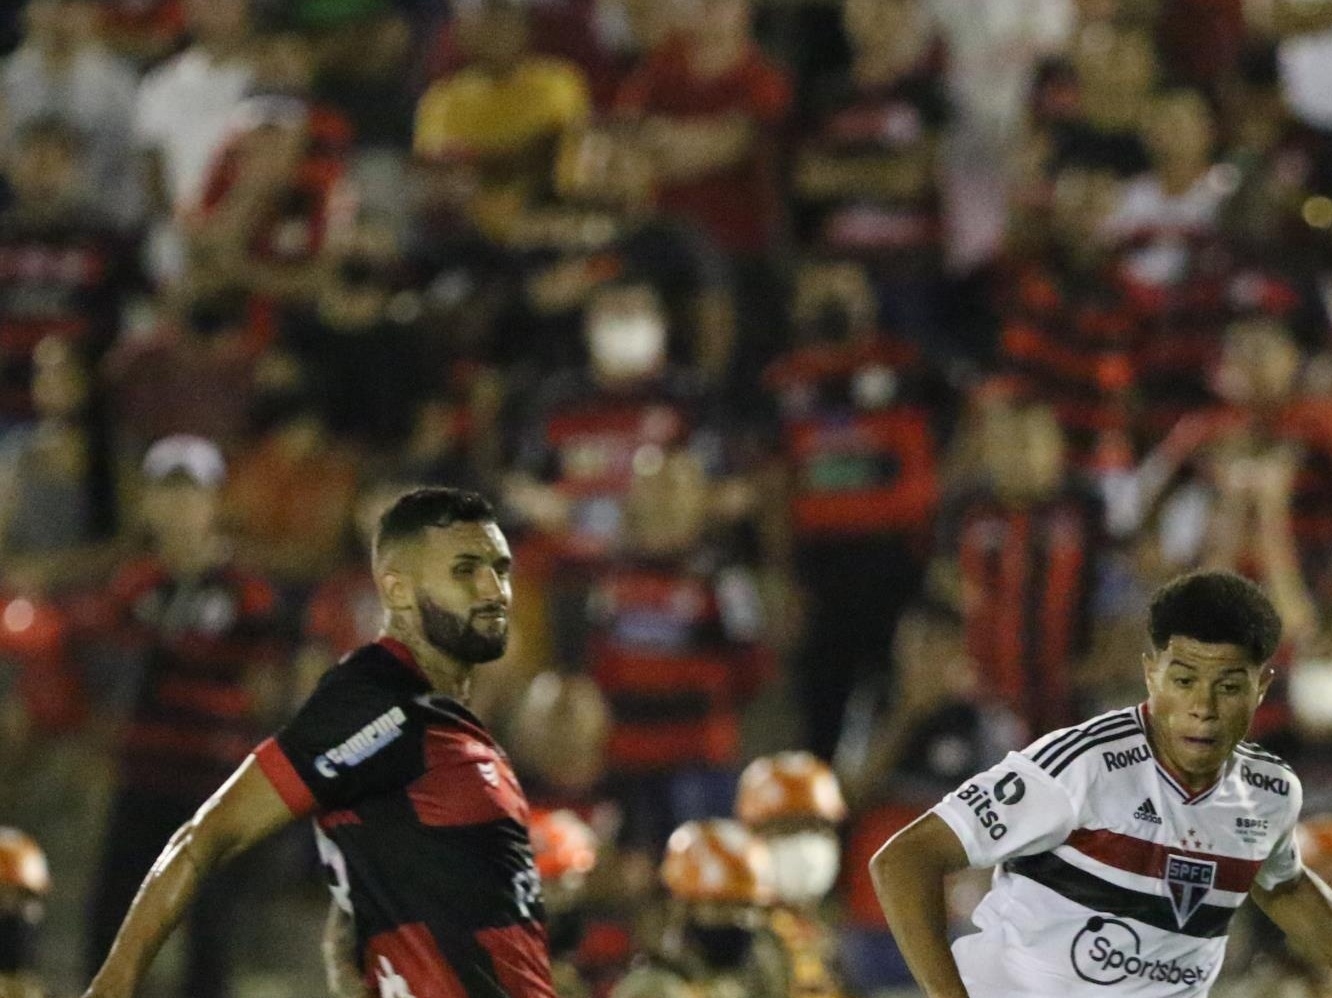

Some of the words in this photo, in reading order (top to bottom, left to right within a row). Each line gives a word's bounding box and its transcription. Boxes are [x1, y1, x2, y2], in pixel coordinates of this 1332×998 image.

[957, 784, 1008, 841] Bitso
[1133, 811, 1163, 826] adidas
[1168, 862, 1213, 881] SPFC
